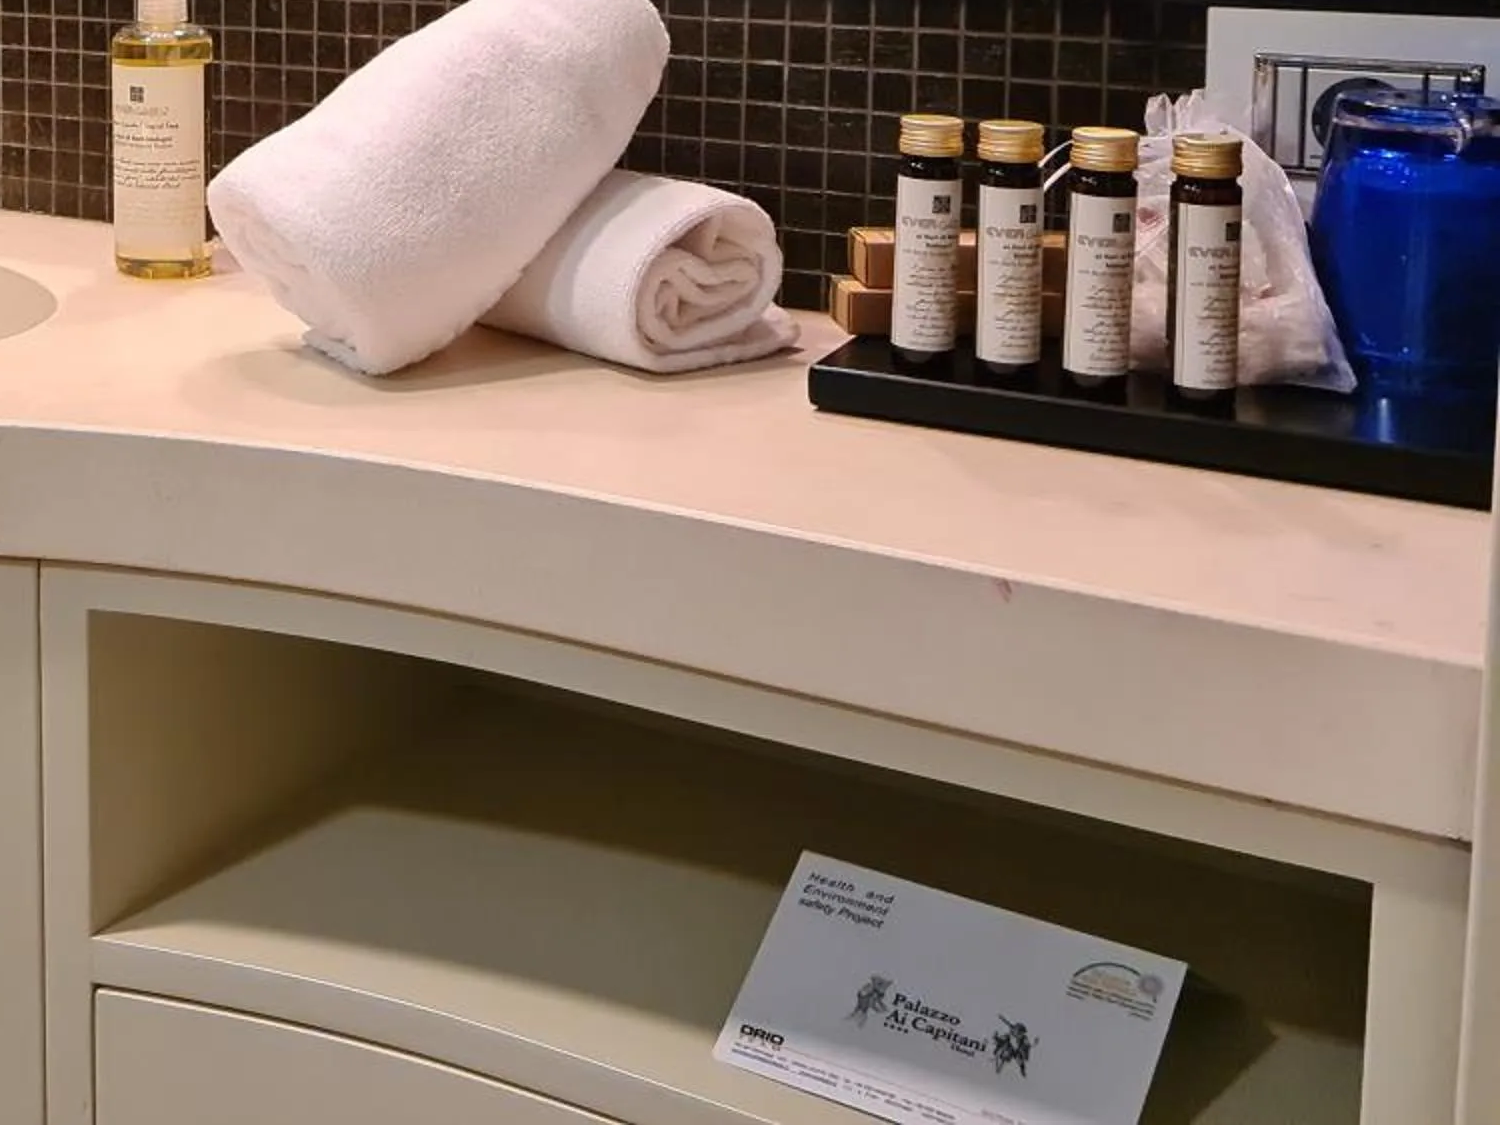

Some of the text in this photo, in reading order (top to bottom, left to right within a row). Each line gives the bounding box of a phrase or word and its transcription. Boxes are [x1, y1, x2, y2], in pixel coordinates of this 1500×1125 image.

[803, 884, 889, 916] Environment
[808, 871, 895, 904] Health and
[837, 906, 885, 929] Project
[892, 992, 961, 1027] Palazzo
[885, 1009, 988, 1053] Ai Capitani
